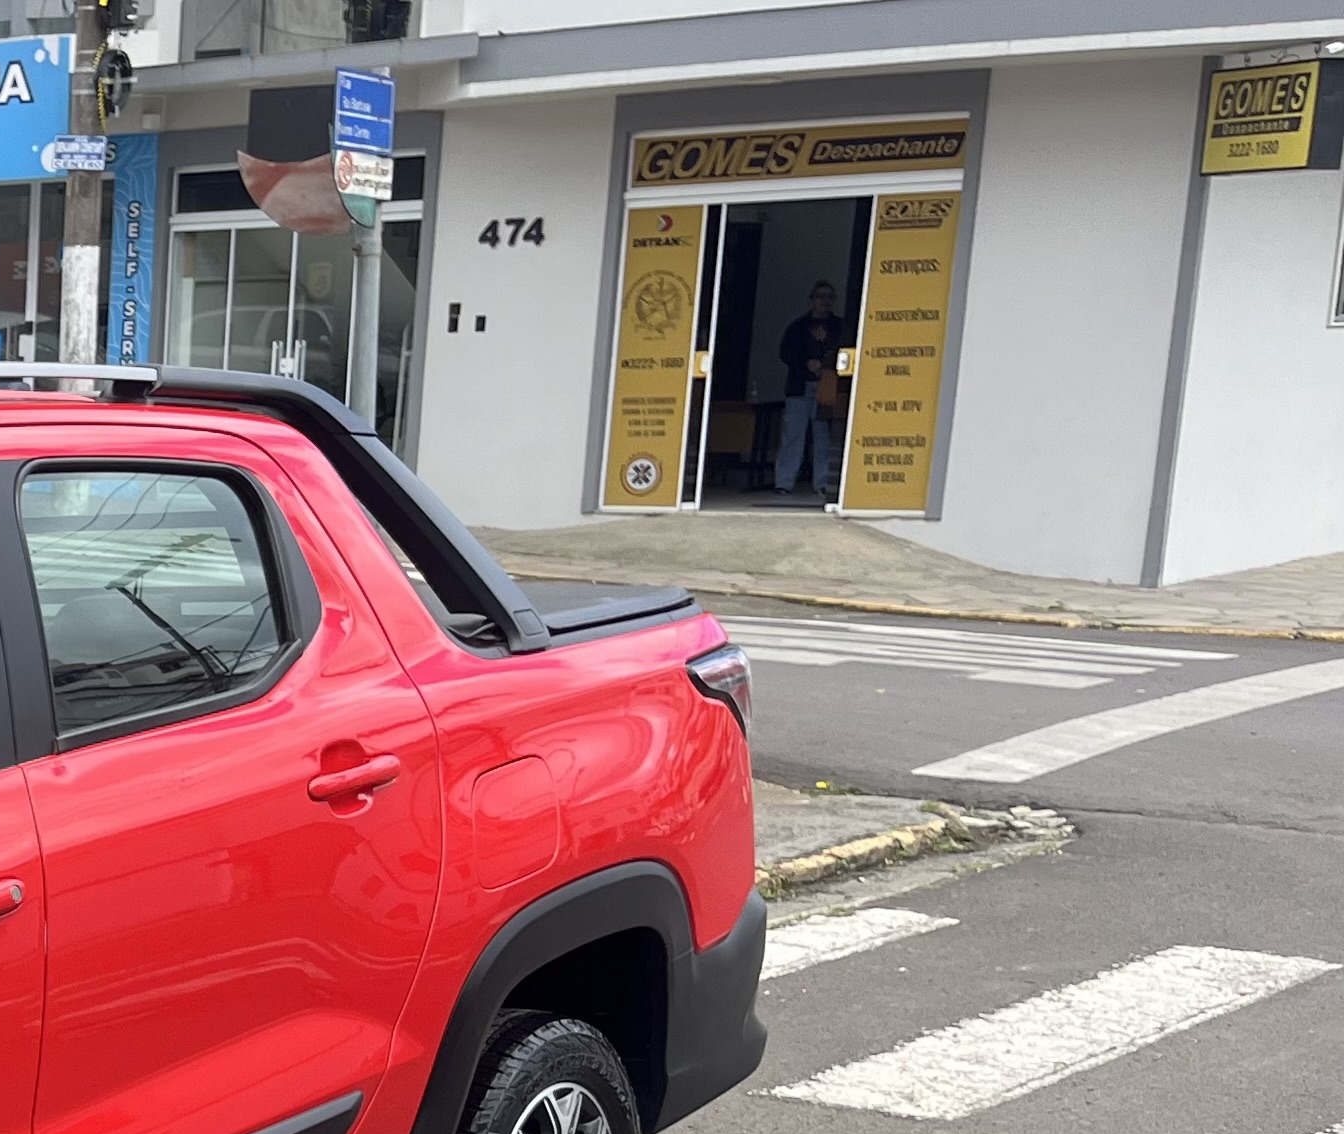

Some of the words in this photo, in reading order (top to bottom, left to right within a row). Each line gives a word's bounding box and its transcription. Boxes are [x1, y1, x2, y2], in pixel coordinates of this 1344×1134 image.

[1218, 75, 1309, 117] GOMES
[641, 133, 806, 182] GOMES
[813, 135, 960, 164] Despachante
[883, 199, 954, 218] GOMES
[478, 217, 545, 248] 474
